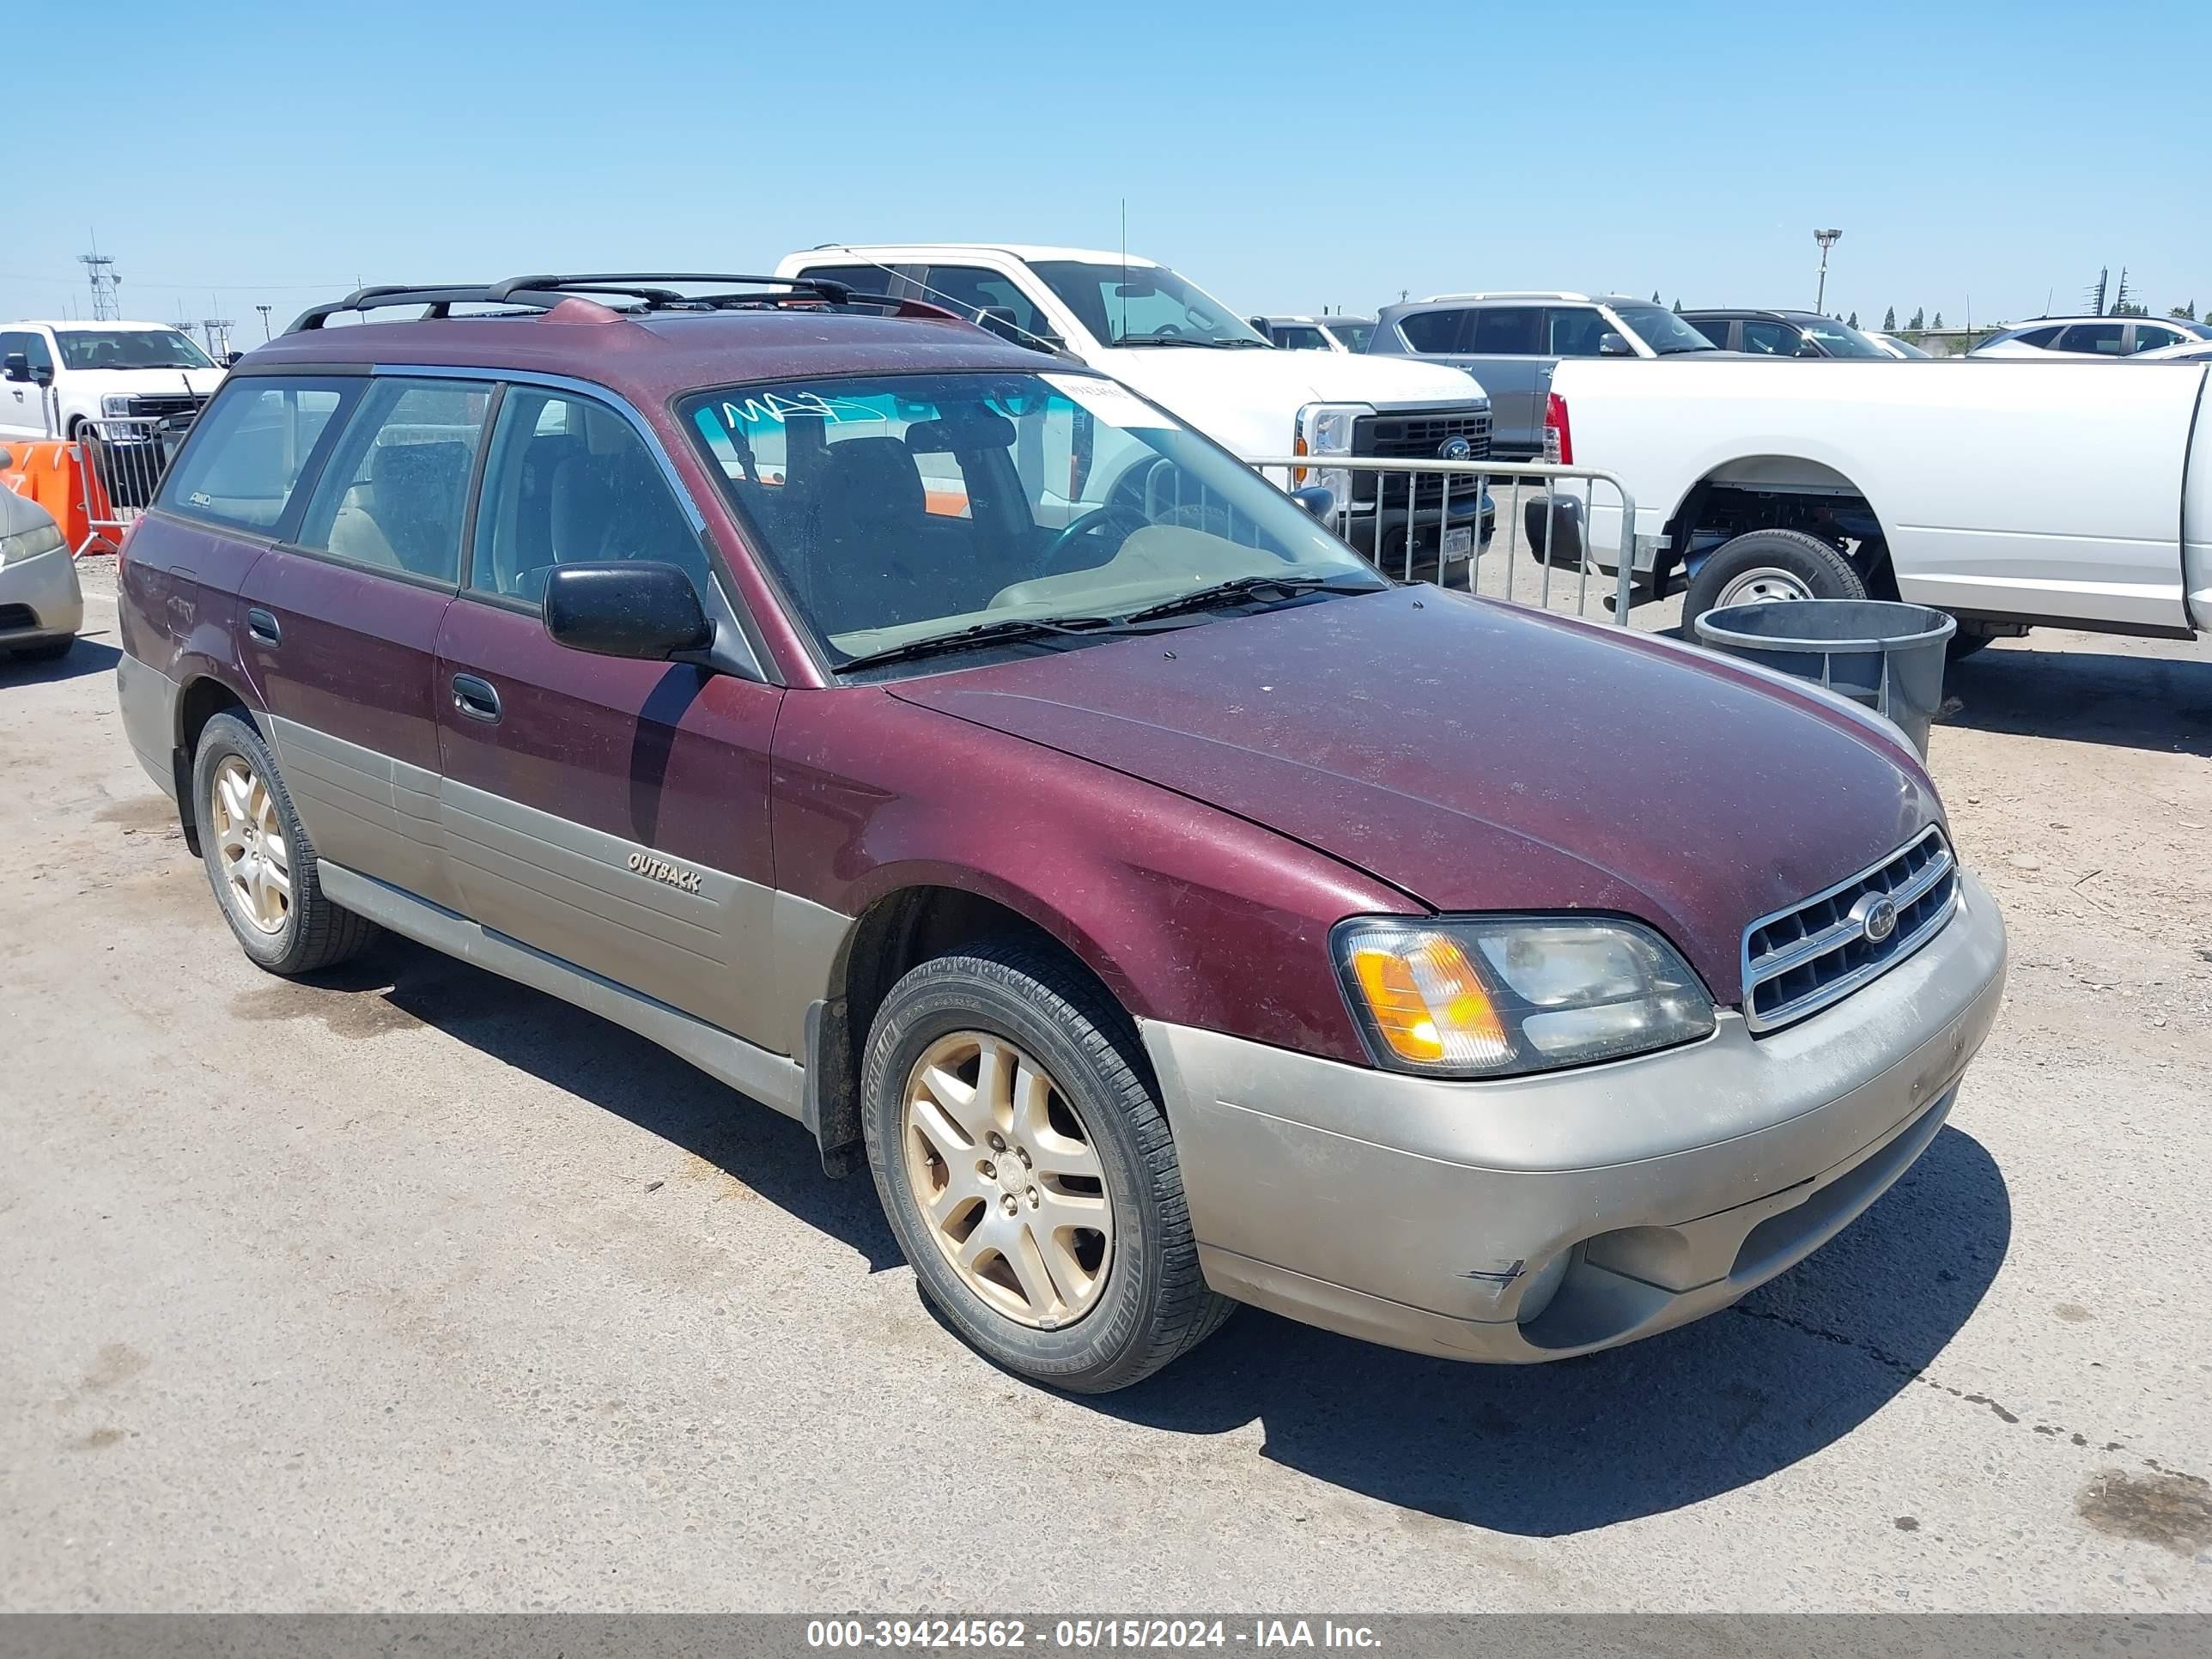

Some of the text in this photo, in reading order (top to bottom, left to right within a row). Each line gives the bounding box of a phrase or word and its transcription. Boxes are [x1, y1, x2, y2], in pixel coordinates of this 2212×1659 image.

[628, 852, 701, 892] OUTBACK
[866, 1023, 897, 1133] MICHELIN
[1099, 1243, 1142, 1359] MICHELIN
